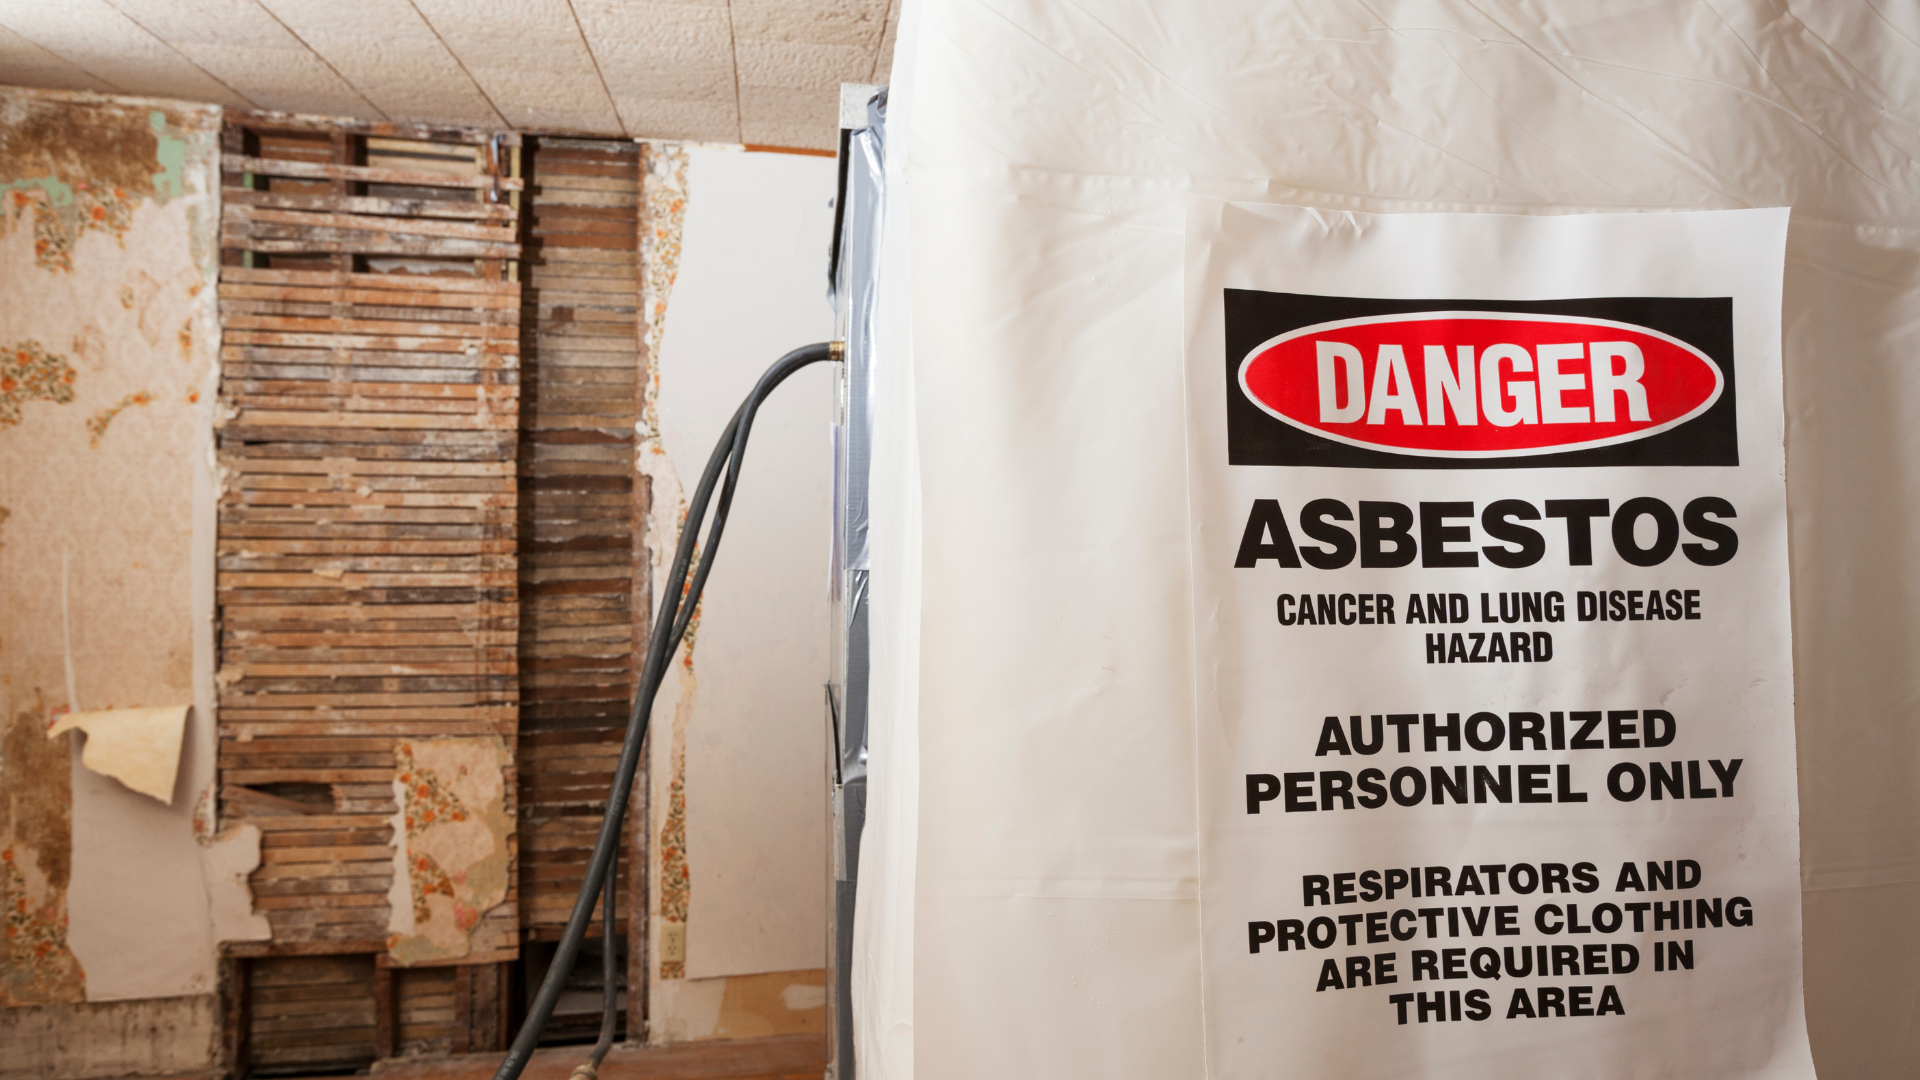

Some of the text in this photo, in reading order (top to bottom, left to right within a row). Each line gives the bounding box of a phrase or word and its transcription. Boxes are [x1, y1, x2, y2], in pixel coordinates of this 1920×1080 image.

[1315, 340, 1652, 427] DANGER
[1234, 496, 1739, 570] ASBESTOS
[1276, 589, 1702, 626] CANCER AND LUNG DISEASE
[1425, 631, 1554, 664] HAZARD
[1314, 709, 1677, 757] AUTHORIZED
[1245, 758, 1744, 815] PERSONNEL ONLY
[1302, 859, 1702, 907] RESPIRATORS AND
[1248, 896, 1755, 955] PROTECTIVE CLOTHING
[1315, 939, 1696, 993] ARE REQUIRED IN
[1388, 984, 1626, 1026] THIS AREA
